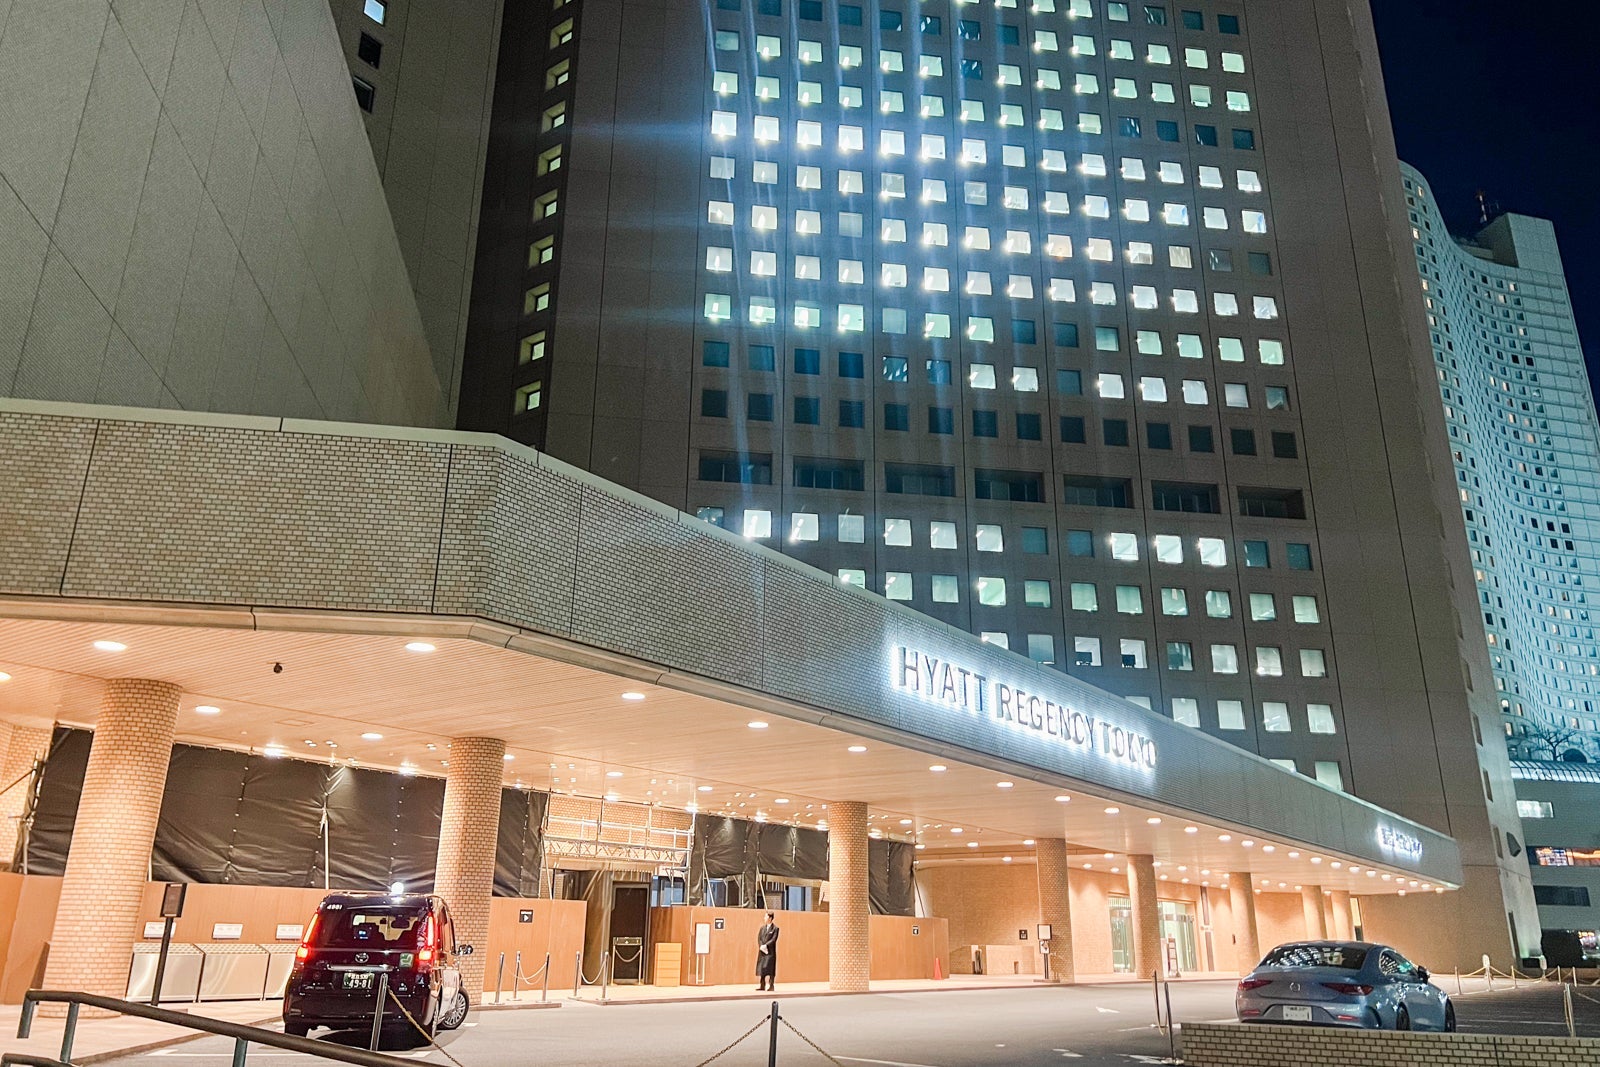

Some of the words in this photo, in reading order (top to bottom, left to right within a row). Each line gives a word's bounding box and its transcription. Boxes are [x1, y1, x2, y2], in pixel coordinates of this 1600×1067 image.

[898, 646, 987, 712] HYATT
[995, 682, 1096, 749] REGENCY
[1098, 721, 1159, 768] TOKYO
